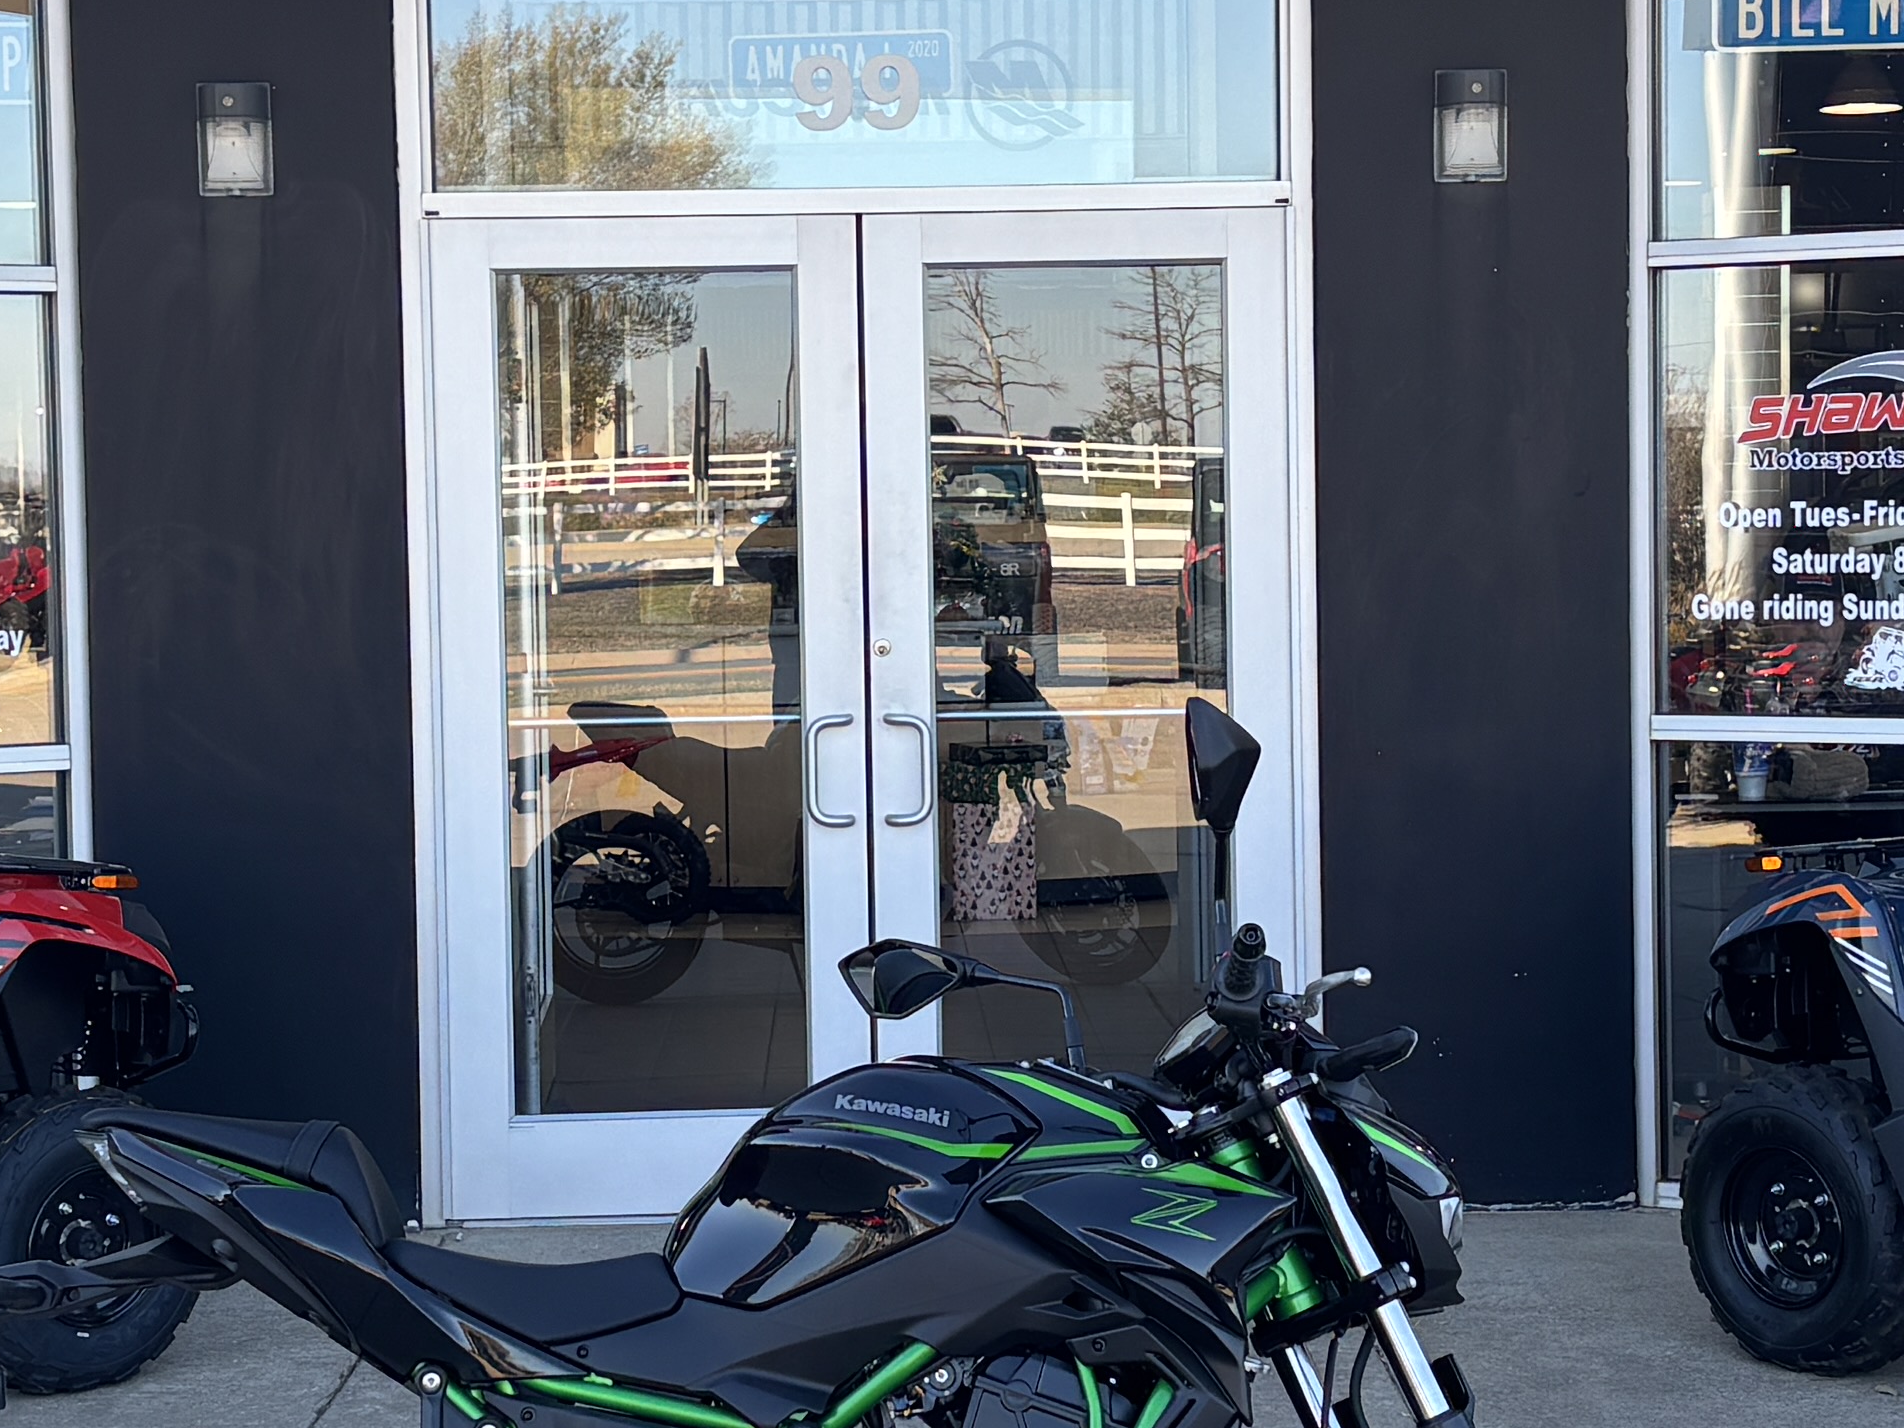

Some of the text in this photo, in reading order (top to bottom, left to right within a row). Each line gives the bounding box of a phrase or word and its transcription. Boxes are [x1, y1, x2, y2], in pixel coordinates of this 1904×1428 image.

[907, 39, 940, 58] 2020
[792, 54, 921, 132] 99
[1719, 501, 1782, 531] Open
[1772, 546, 1887, 580] Saturday
[1691, 593, 1756, 622] Gone
[1762, 592, 1835, 626] riding
[834, 1091, 952, 1129] Kawasaki
